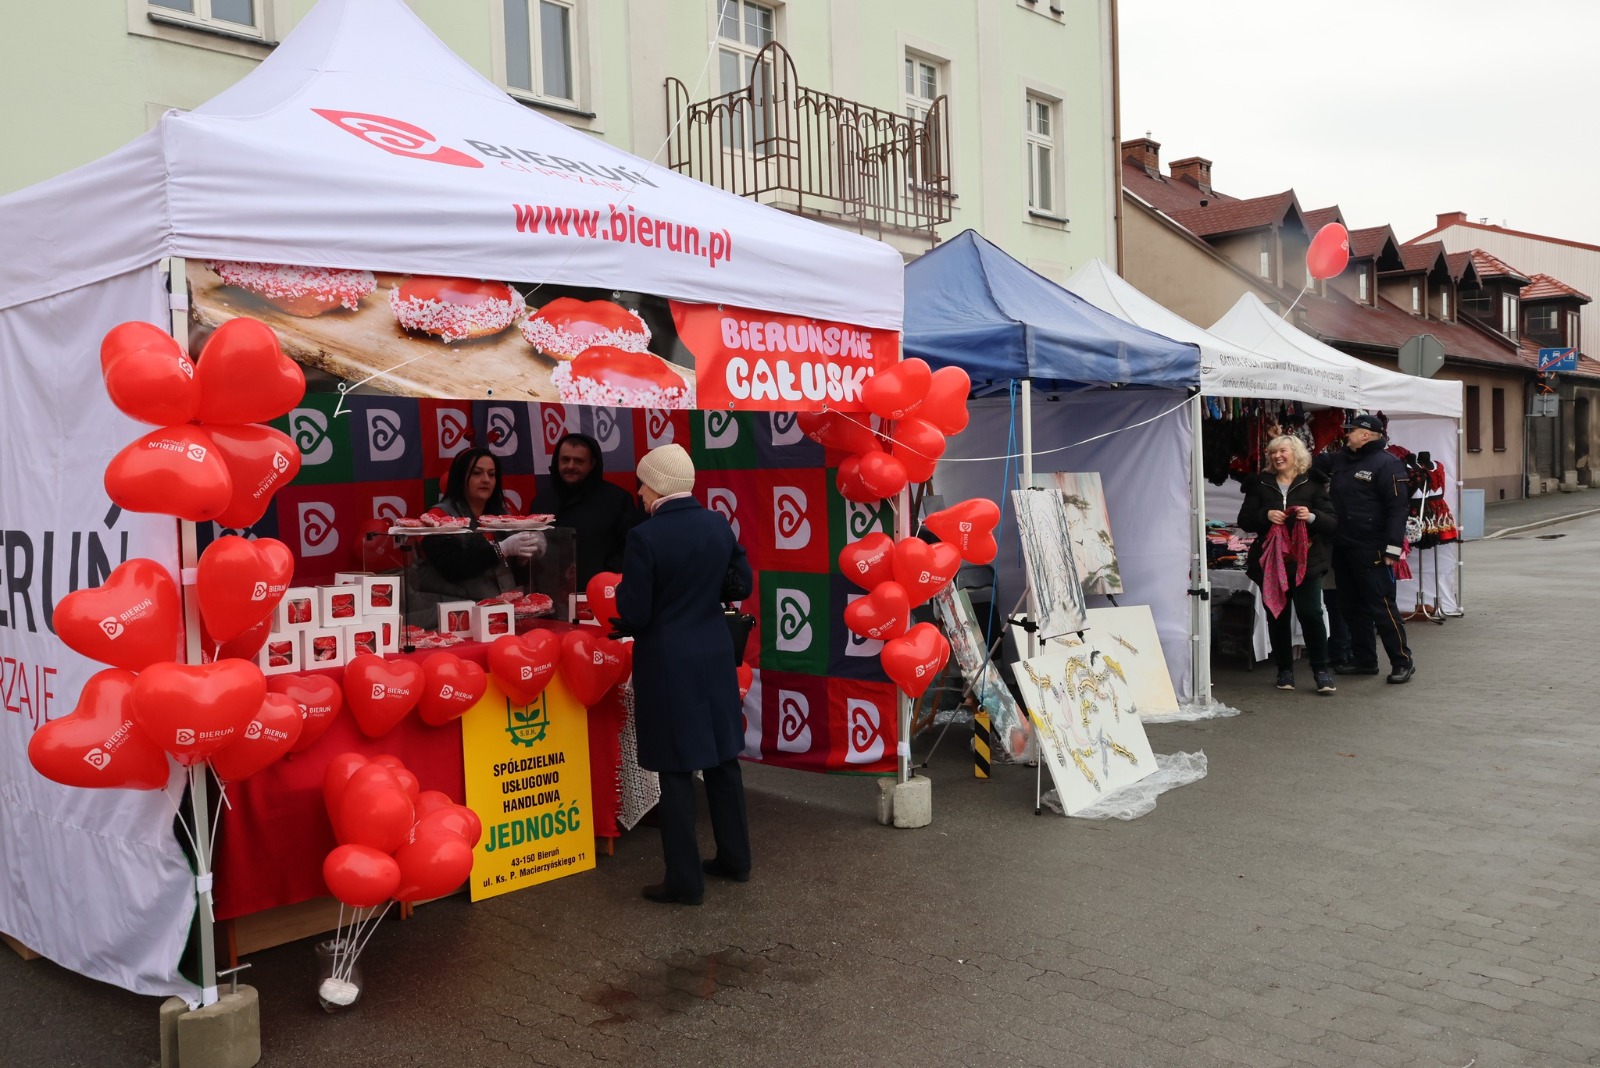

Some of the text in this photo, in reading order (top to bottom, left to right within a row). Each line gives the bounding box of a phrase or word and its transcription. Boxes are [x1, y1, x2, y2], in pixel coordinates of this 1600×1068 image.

[463, 138, 660, 188] BIERUŃ
[512, 203, 732, 268] www.bierun.pl
[148, 441, 185, 453] BIERUŃ
[120, 597, 153, 621] BIERUŃ
[104, 719, 134, 750] BIERUŃ
[199, 726, 235, 739] BIERUŃ
[264, 727, 289, 740] BIERUŃ
[493, 751, 566, 777] SPÓŁDZIELNIA
[502, 770, 560, 795] USŁUGOWO
[503, 789, 561, 814] HANDLOWA
[484, 799, 581, 853] JEDNOŚĆ
[511, 846, 560, 867] 43-150 Bieruń
[483, 852, 585, 888] ul. Ks. P. Macierzyńskiego 11
